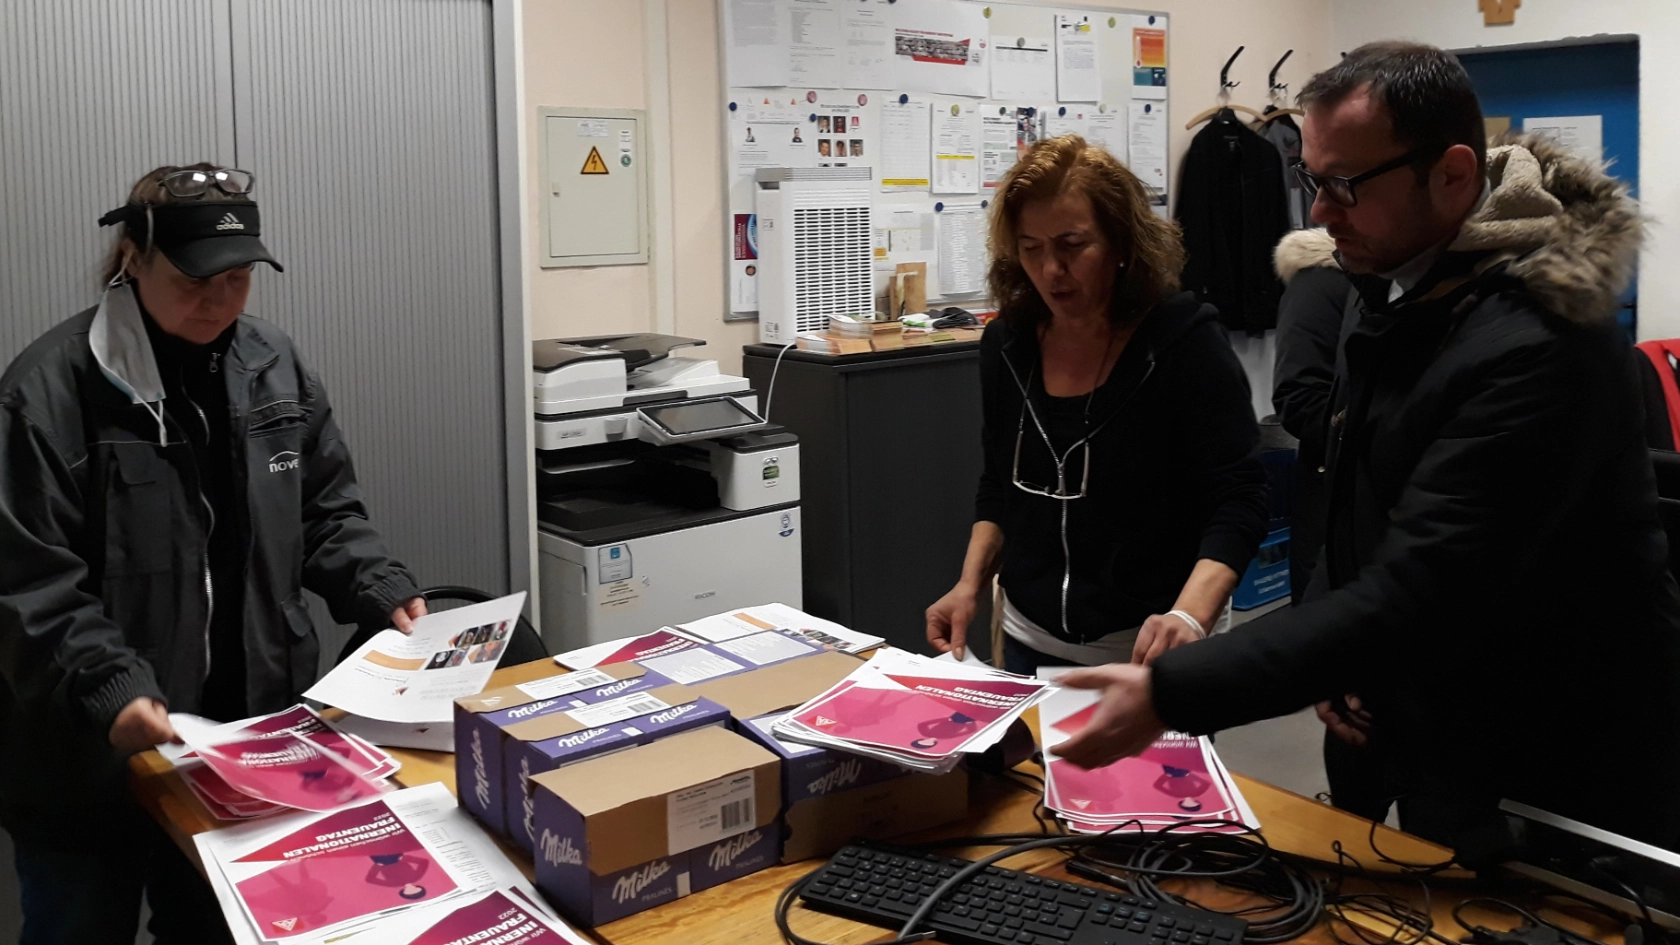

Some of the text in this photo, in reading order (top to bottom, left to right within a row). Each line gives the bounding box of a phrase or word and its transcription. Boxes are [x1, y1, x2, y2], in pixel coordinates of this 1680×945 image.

[216, 222, 245, 230] adidas
[596, 678, 643, 698] Milka
[508, 699, 558, 719] Milka
[650, 703, 698, 724] Milka
[558, 727, 610, 749] Milka
[471, 728, 491, 810] Milka
[807, 758, 862, 795] Milka
[283, 822, 402, 859] INERNATIONALEN
[315, 816, 396, 842] FRAUENTAG
[540, 827, 583, 869] Milka
[708, 829, 764, 872] Milka
[611, 860, 672, 905] Milka
